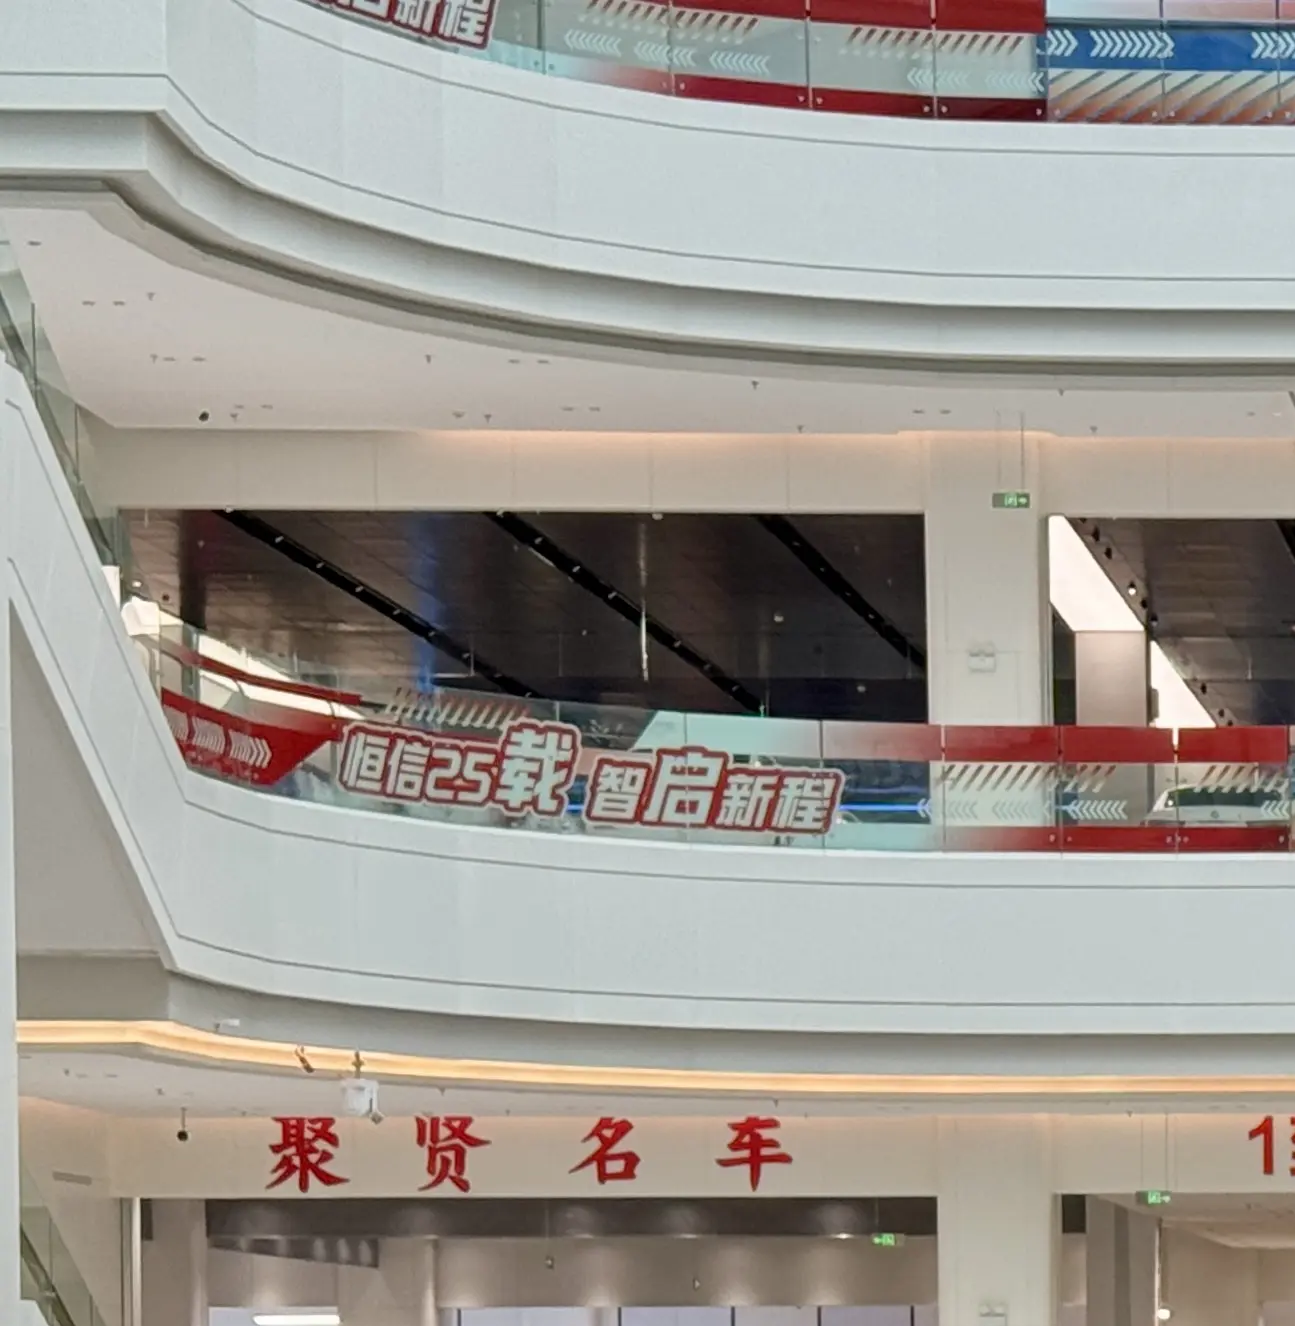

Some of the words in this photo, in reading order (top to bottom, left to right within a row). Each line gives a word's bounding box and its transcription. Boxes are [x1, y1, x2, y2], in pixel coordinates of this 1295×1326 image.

[342, 727, 575, 811] 恒信25载
[590, 750, 838, 832] 智启新程
[265, 1115, 794, 1193] 聚贤名车
